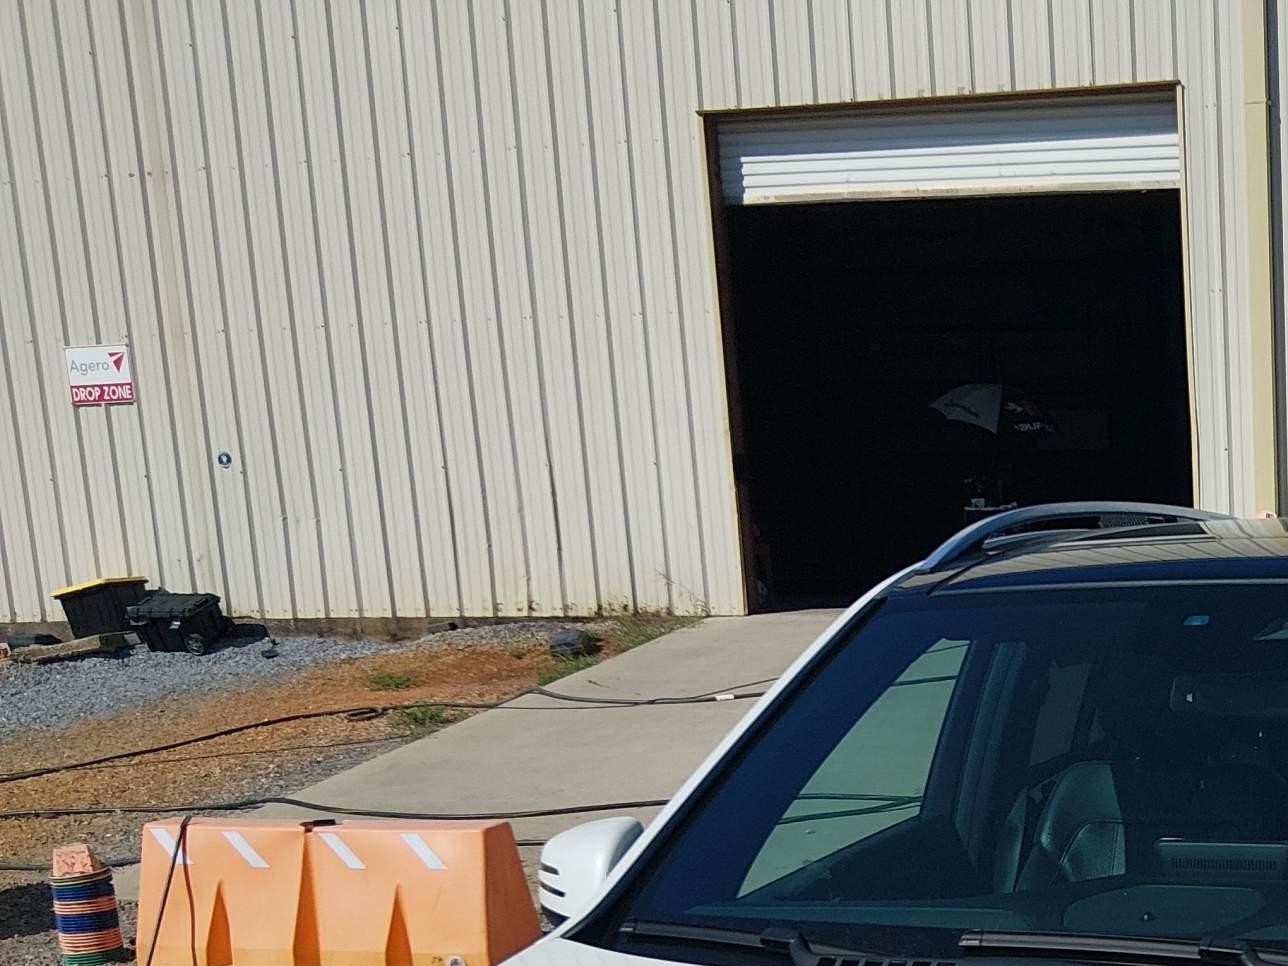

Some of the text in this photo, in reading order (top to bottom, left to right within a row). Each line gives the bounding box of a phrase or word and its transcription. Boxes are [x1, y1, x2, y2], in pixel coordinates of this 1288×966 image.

[70, 360, 110, 376] Agero
[72, 385, 133, 402] DROP ZONE
